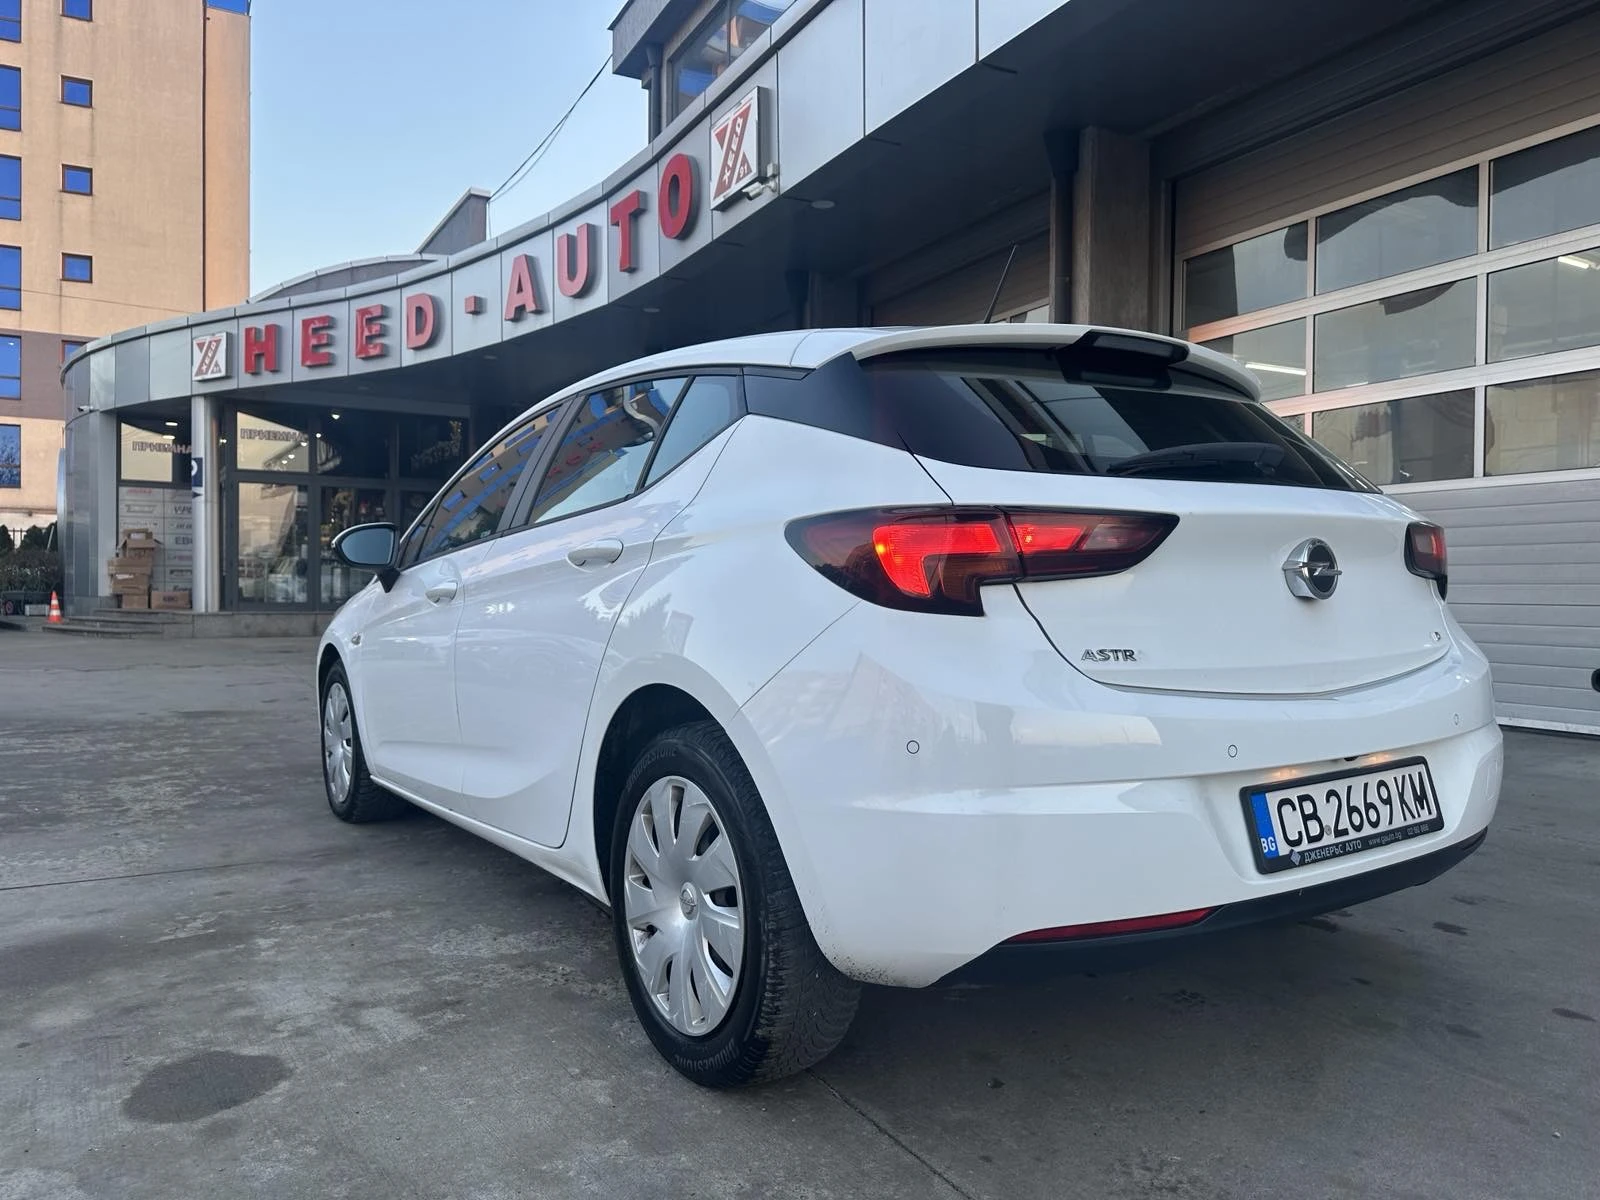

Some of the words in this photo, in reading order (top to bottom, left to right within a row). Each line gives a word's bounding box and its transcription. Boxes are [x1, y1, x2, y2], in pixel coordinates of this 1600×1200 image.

[1080, 648, 1137, 662] ASTR
[1261, 837, 1276, 853] BG
[1304, 844, 1344, 863] ДЖЕНЕРЪС
[1345, 839, 1362, 854] АУТО
